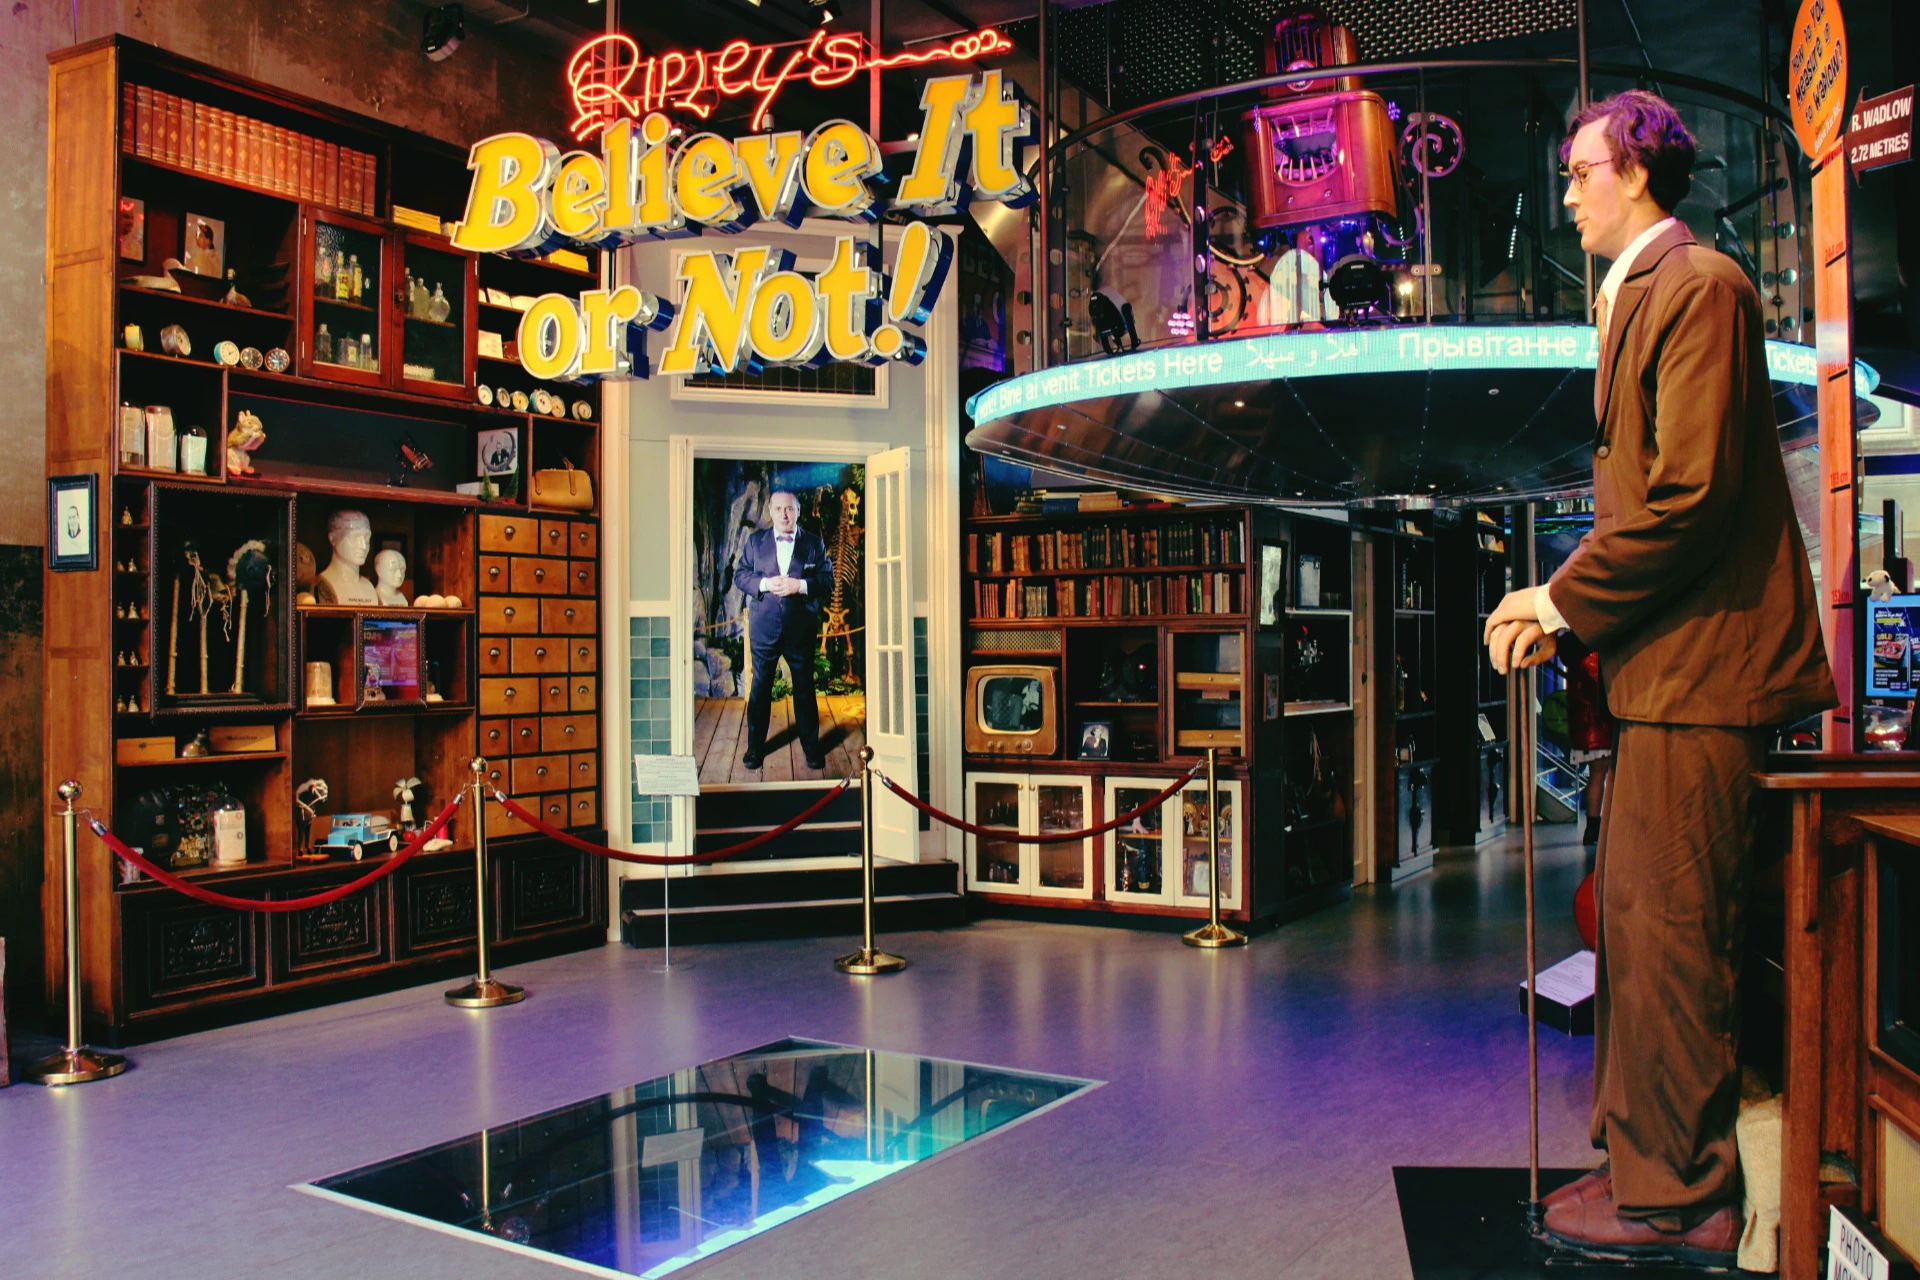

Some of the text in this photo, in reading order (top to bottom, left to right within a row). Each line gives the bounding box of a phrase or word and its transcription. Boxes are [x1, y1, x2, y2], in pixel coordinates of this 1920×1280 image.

[1851, 113, 1862, 133] R.
[1863, 96, 1912, 130] WADLOW
[450, 113, 876, 253] Believe
[896, 69, 1019, 206] It
[1851, 144, 1869, 164] 2.72
[1869, 132, 1909, 160] METRES
[518, 221, 931, 380] or Not!
[1399, 331, 1577, 364] Прывітанне
[1765, 343, 1817, 377] Tickets
[1025, 380, 1039, 401] ai
[1041, 368, 1080, 396] venit
[1084, 358, 1156, 389] Tickets
[1164, 350, 1223, 377] Here
[1841, 1223, 1874, 1280] PHOTO
